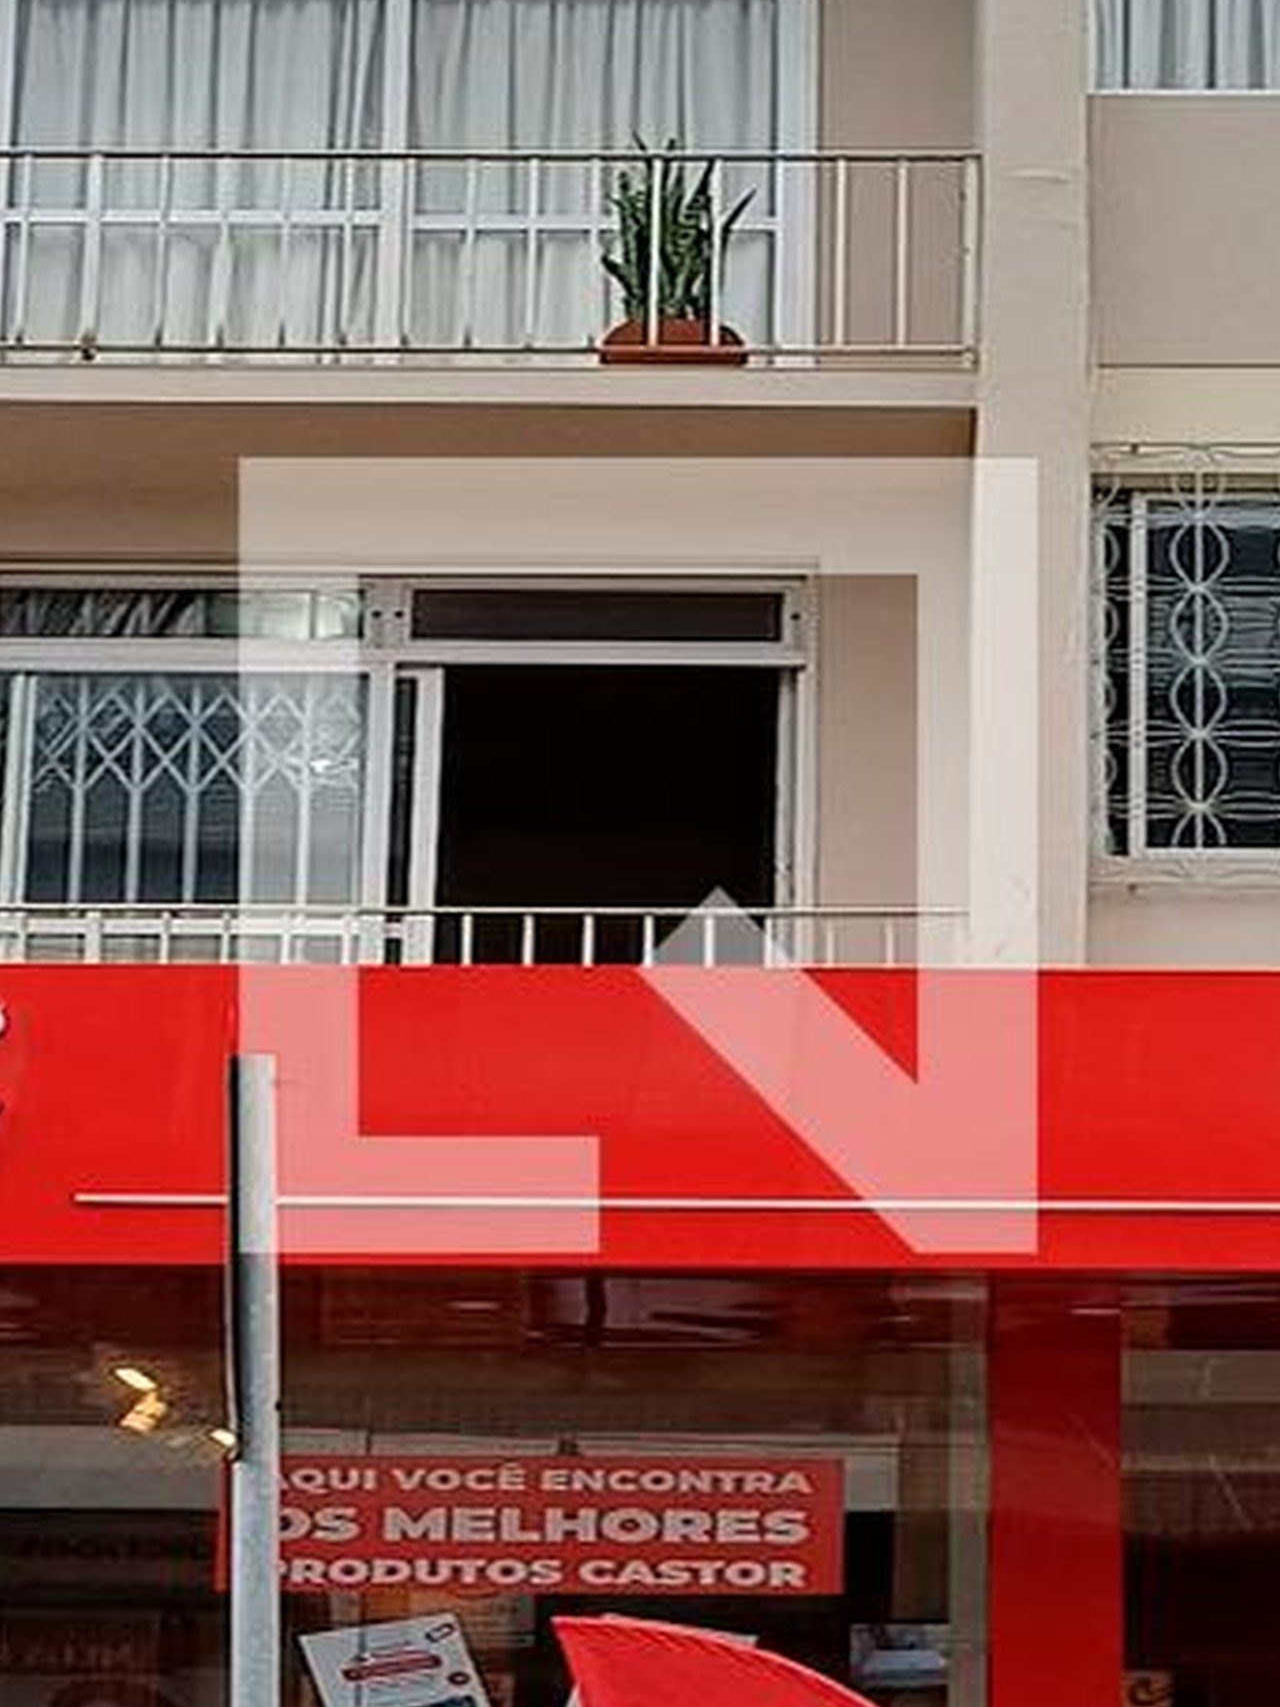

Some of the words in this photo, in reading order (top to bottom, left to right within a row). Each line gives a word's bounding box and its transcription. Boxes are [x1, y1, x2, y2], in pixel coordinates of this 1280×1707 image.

[391, 1462, 526, 1492] VOCÊ
[540, 1468, 815, 1495] ENCONTRA
[382, 1506, 811, 1545] MELHORES
[577, 1558, 808, 1589] CASTOR
